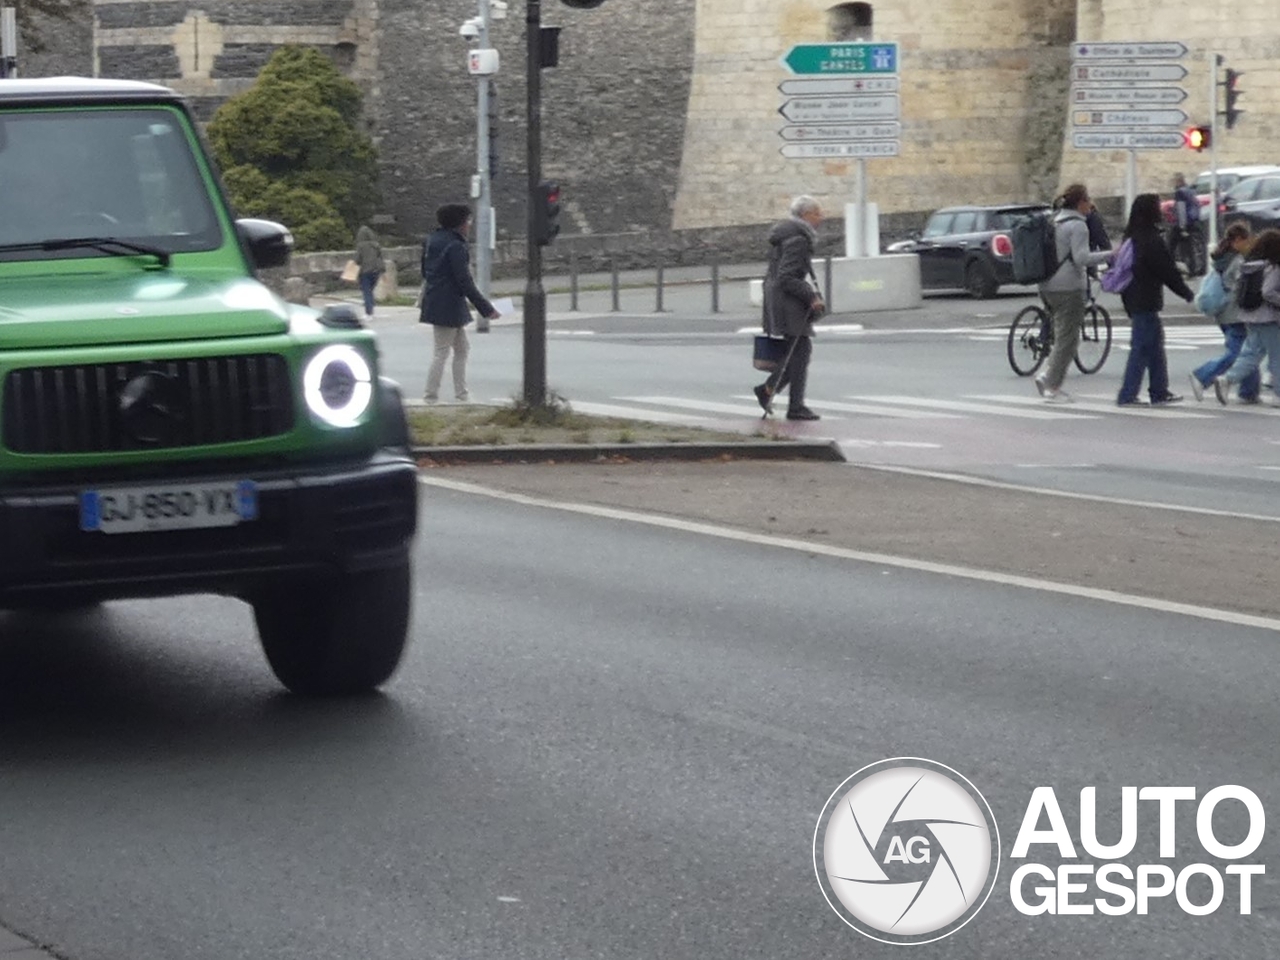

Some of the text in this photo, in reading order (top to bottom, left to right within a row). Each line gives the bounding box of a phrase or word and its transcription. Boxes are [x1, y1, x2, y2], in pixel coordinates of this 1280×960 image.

[829, 47, 865, 58] PARIS
[820, 60, 865, 71] NANTES
[1092, 68, 1150, 78] Cathédrale
